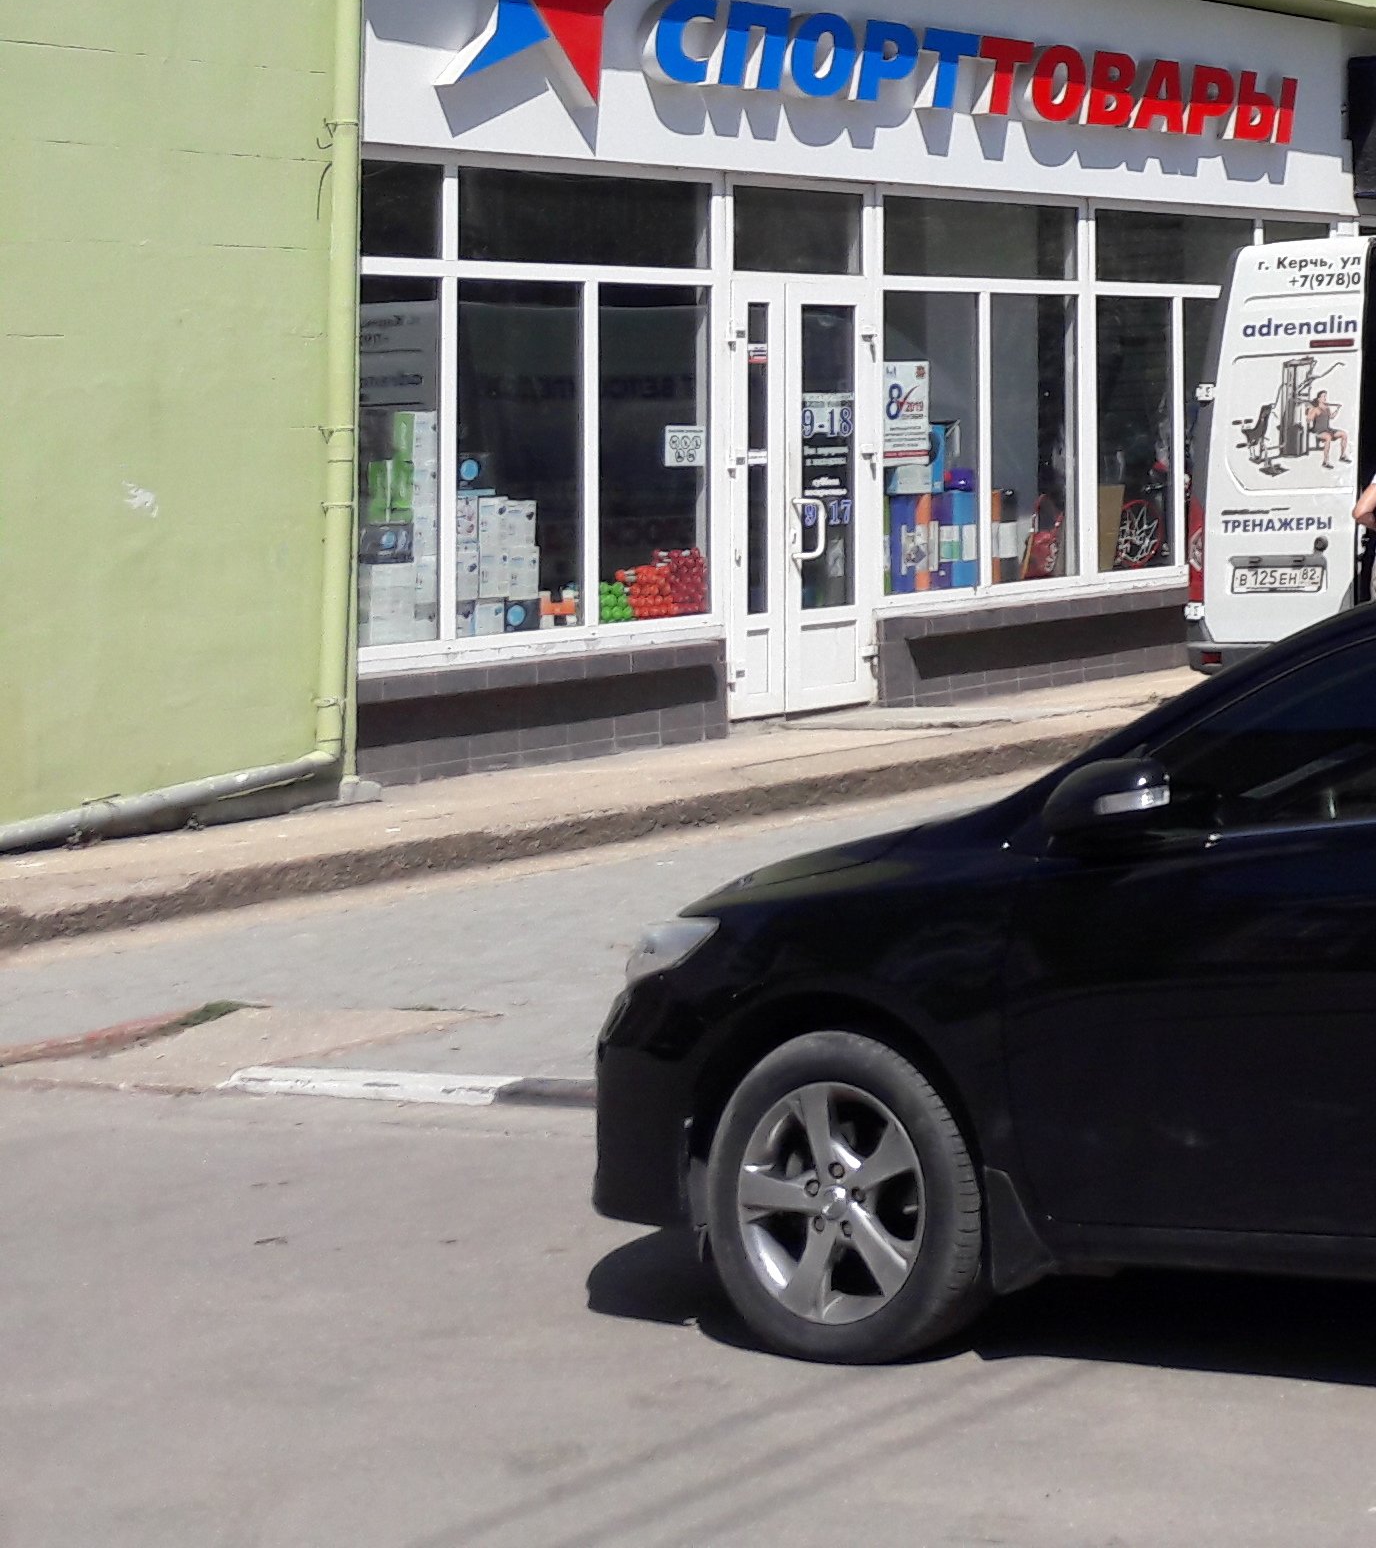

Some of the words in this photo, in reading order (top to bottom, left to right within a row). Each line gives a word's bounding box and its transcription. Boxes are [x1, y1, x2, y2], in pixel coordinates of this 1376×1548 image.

[1257, 260, 1270, 271] г.
[1276, 256, 1334, 272] Керчь,
[1288, 271, 1361, 291] +7(978)0
[1242, 314, 1358, 339] adrenalin
[886, 384, 902, 420] 8
[1221, 516, 1333, 534] ТРЕНАЖЕРЫ
